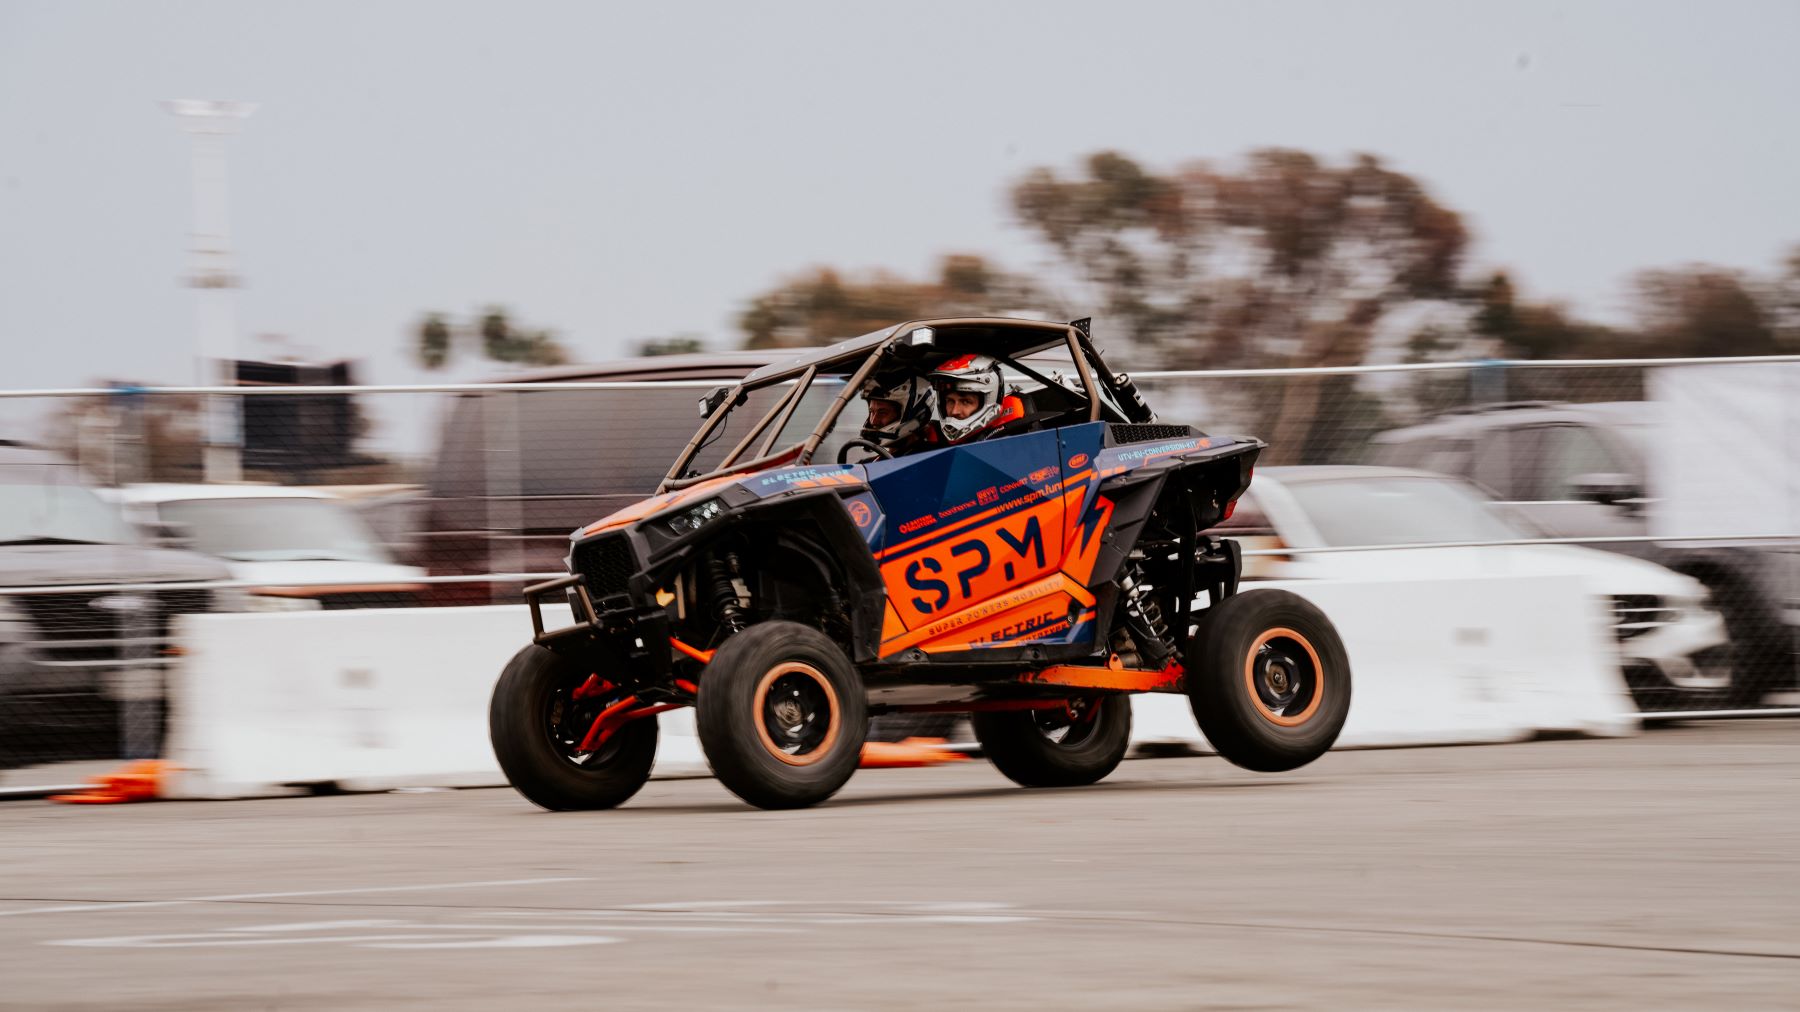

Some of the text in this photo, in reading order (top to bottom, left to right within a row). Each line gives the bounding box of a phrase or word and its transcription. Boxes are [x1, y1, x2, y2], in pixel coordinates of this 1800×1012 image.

[1118, 440, 1197, 462] UTV-EV-CONVERSION-KIT
[761, 469, 817, 486] ELECTRIC
[995, 481, 1062, 513] www.spm.fun
[905, 515, 1046, 614] SPM
[929, 580, 1061, 635] SUPER POWERS MOBILITY
